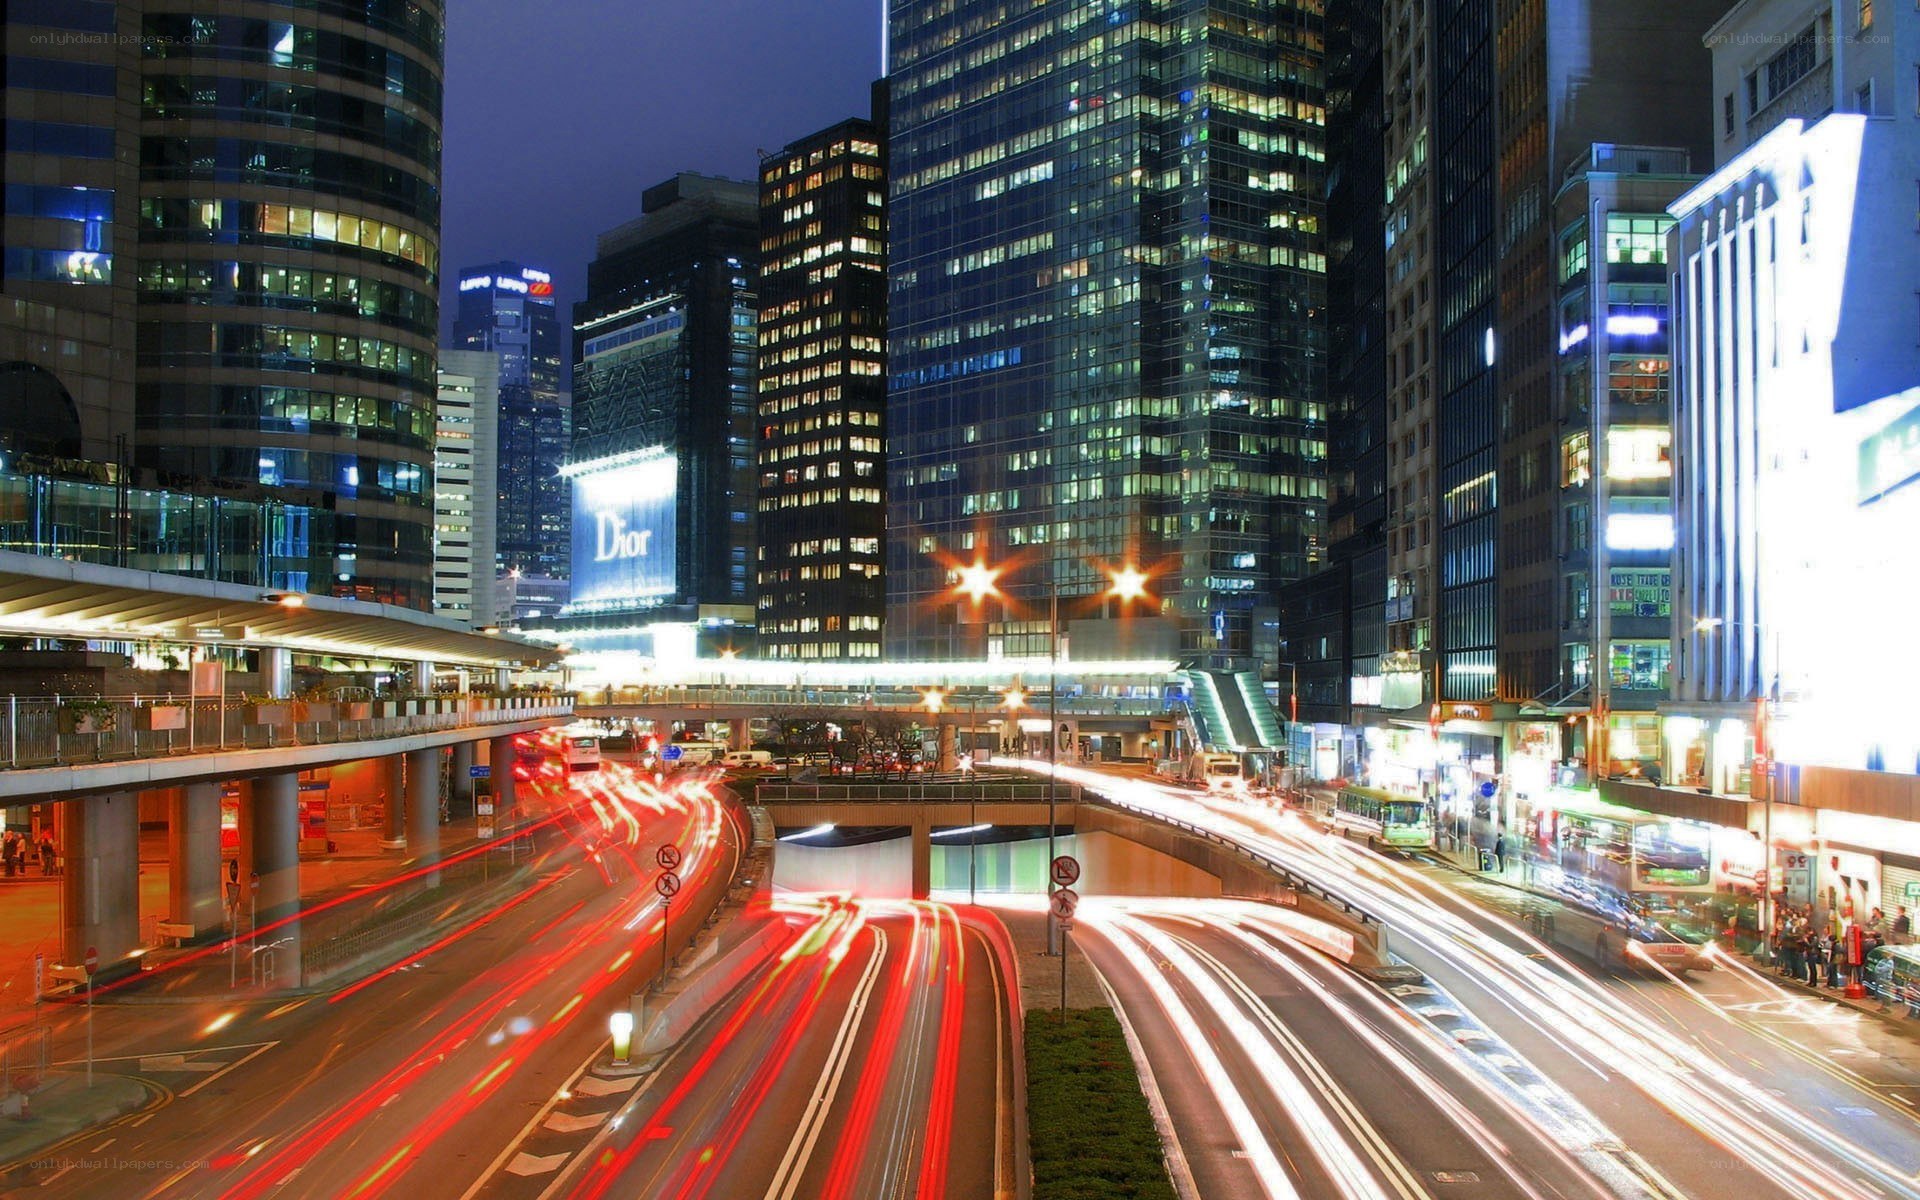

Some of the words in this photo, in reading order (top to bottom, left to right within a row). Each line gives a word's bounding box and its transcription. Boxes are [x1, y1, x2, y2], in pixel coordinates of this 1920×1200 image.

[460, 275, 491, 291] LIPPO
[496, 276, 528, 293] LIPPO
[594, 510, 652, 562] Dior
